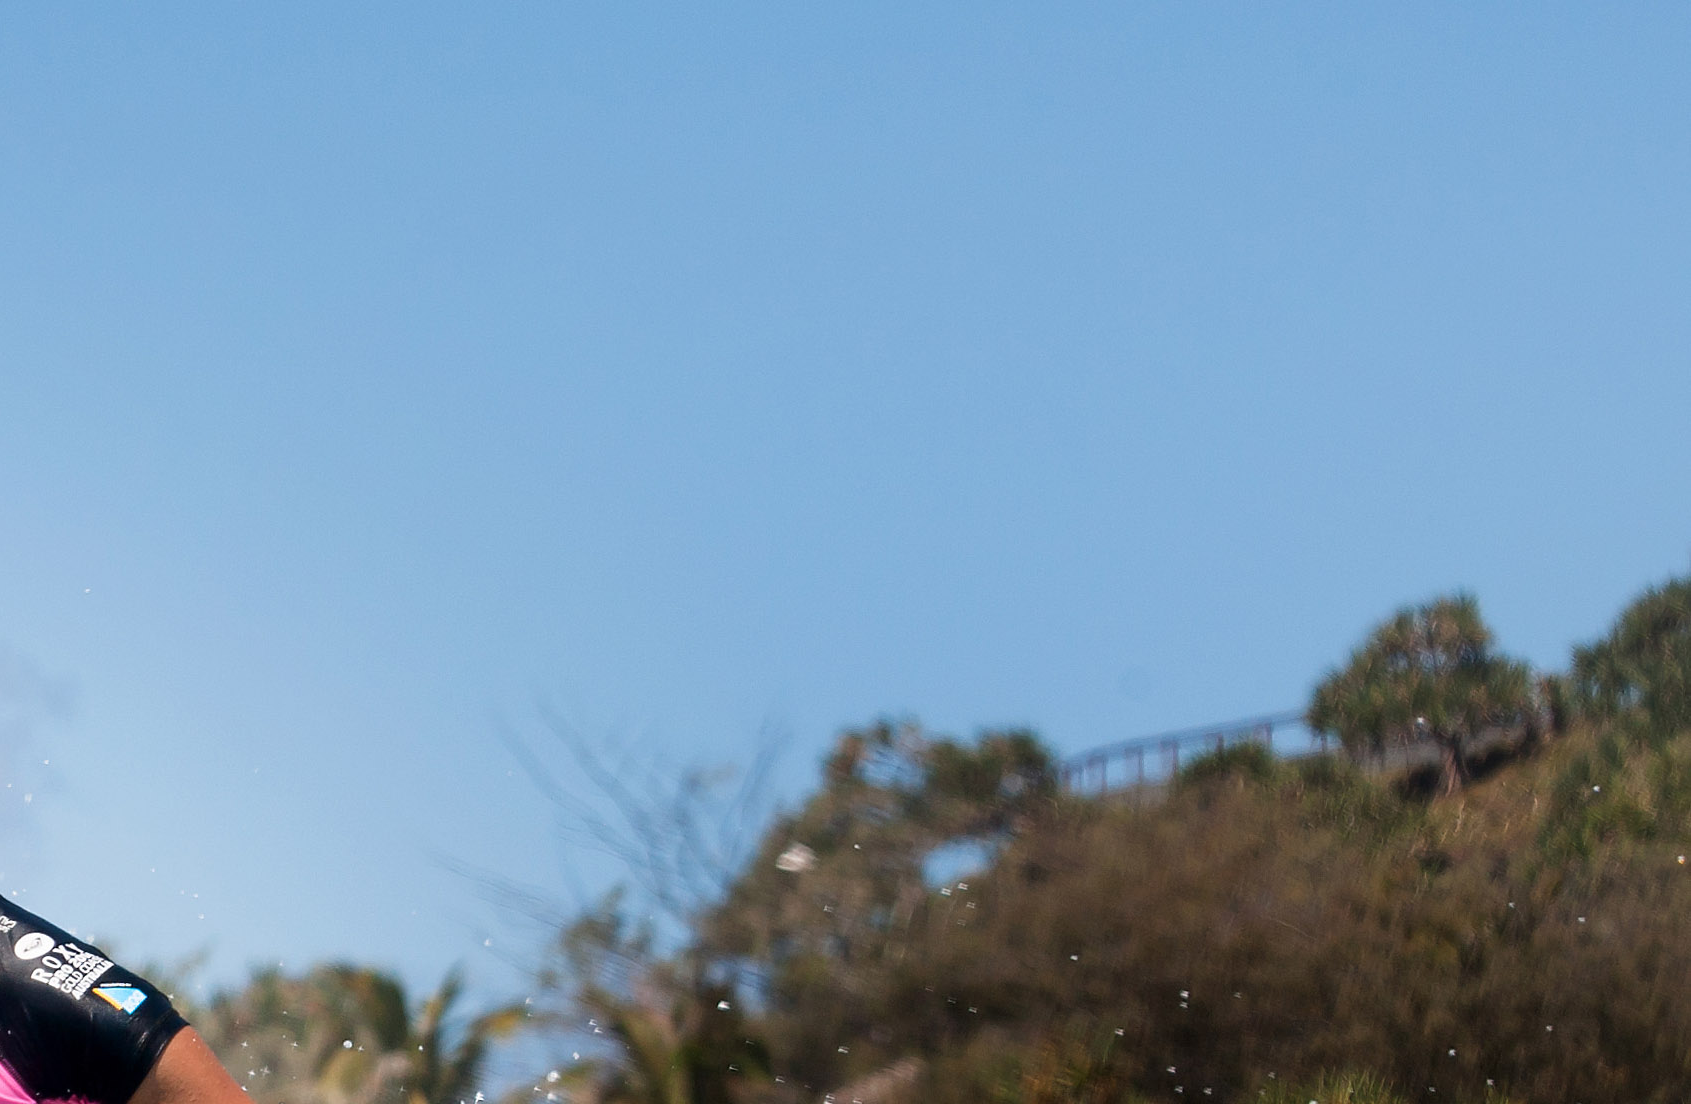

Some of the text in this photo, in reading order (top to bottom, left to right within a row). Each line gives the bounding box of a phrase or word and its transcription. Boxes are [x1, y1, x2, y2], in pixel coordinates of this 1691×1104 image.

[30, 942, 84, 984] ROXY
[48, 963, 75, 989] PRO
[71, 959, 114, 1000] AUSTRALIA
[61, 972, 84, 994] GOLD
